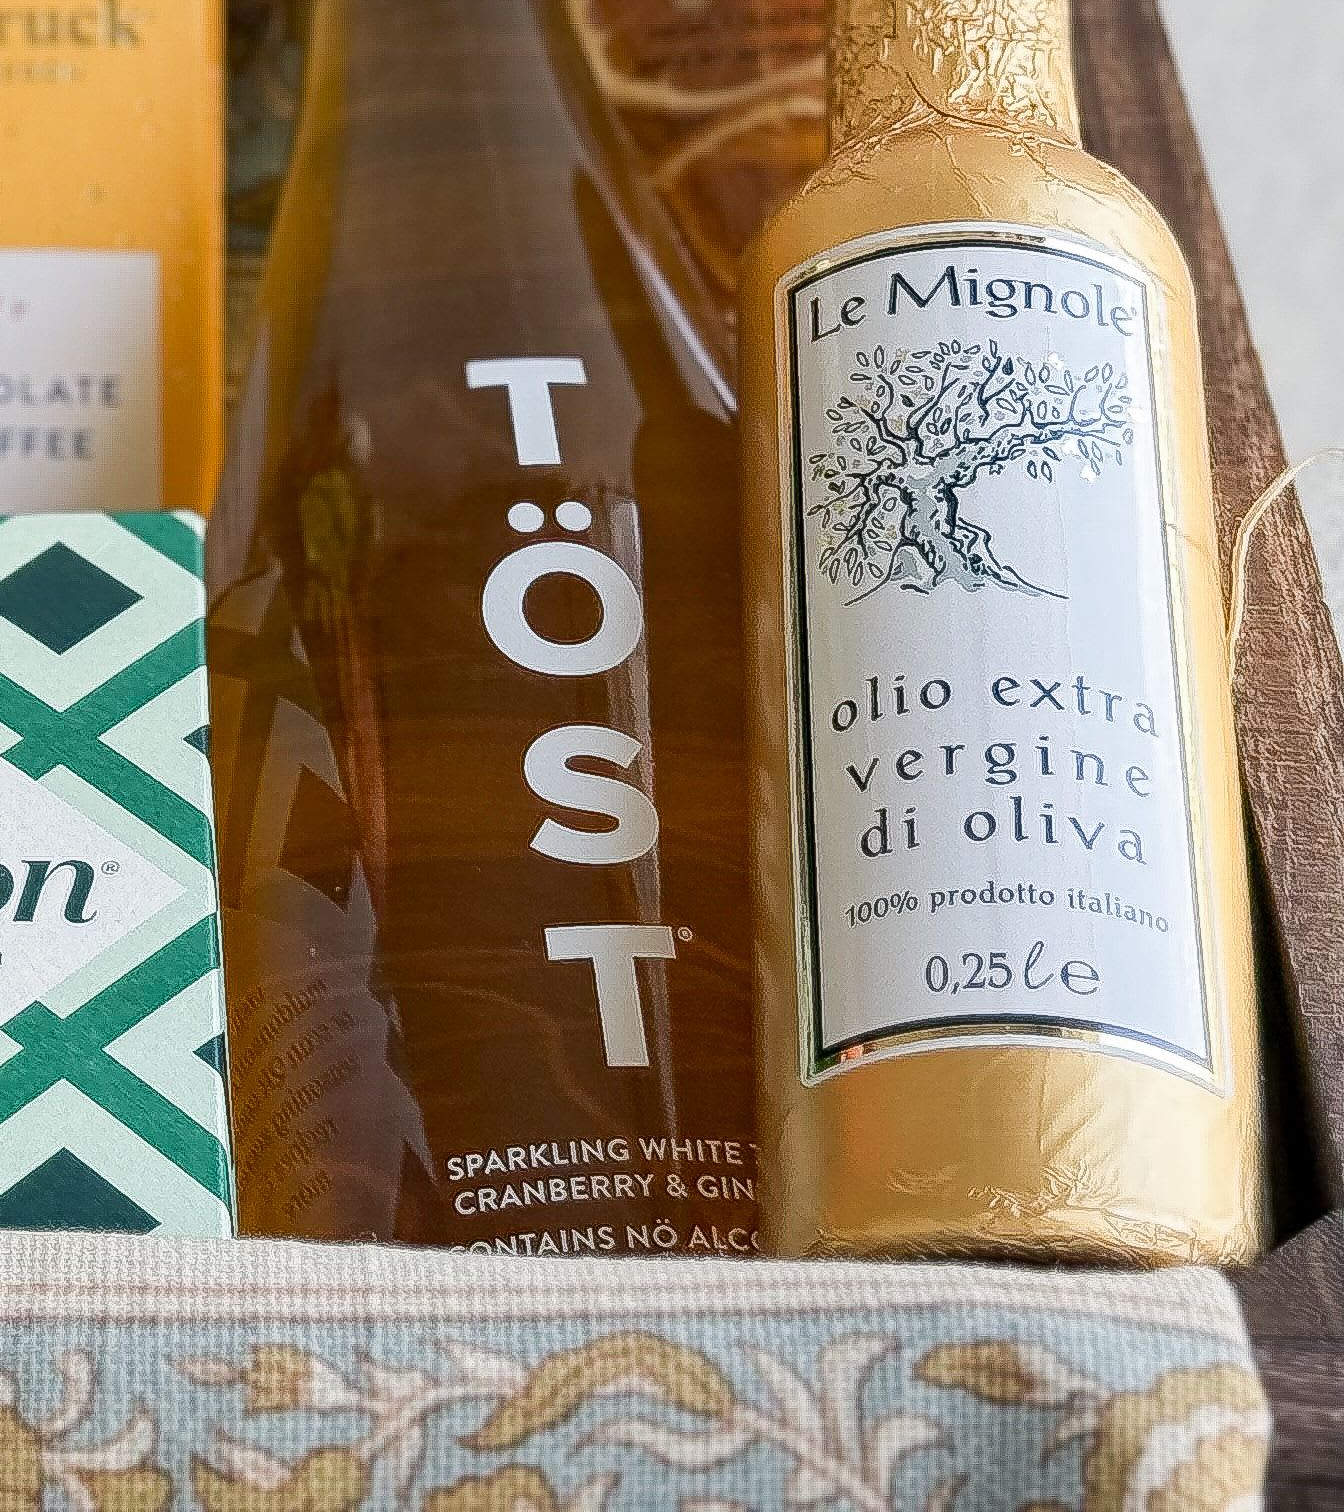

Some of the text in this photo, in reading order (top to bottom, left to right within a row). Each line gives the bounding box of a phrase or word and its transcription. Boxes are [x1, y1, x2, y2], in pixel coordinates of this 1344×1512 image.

[810, 265, 1138, 341] Le Mignole
[831, 675, 1160, 738] olio extra
[845, 735, 1151, 797] vergine
[860, 795, 1148, 865] di oliva
[845, 880, 1170, 933] 100% prodotto italiano
[925, 951, 1013, 995] 0,25
[447, 1138, 630, 1181] SPARKLING
[638, 1137, 744, 1166] WHITE
[453, 1173, 655, 1216] CRANBERRY
[666, 1173, 689, 1200] &
[626, 1217, 678, 1249] NÖ
